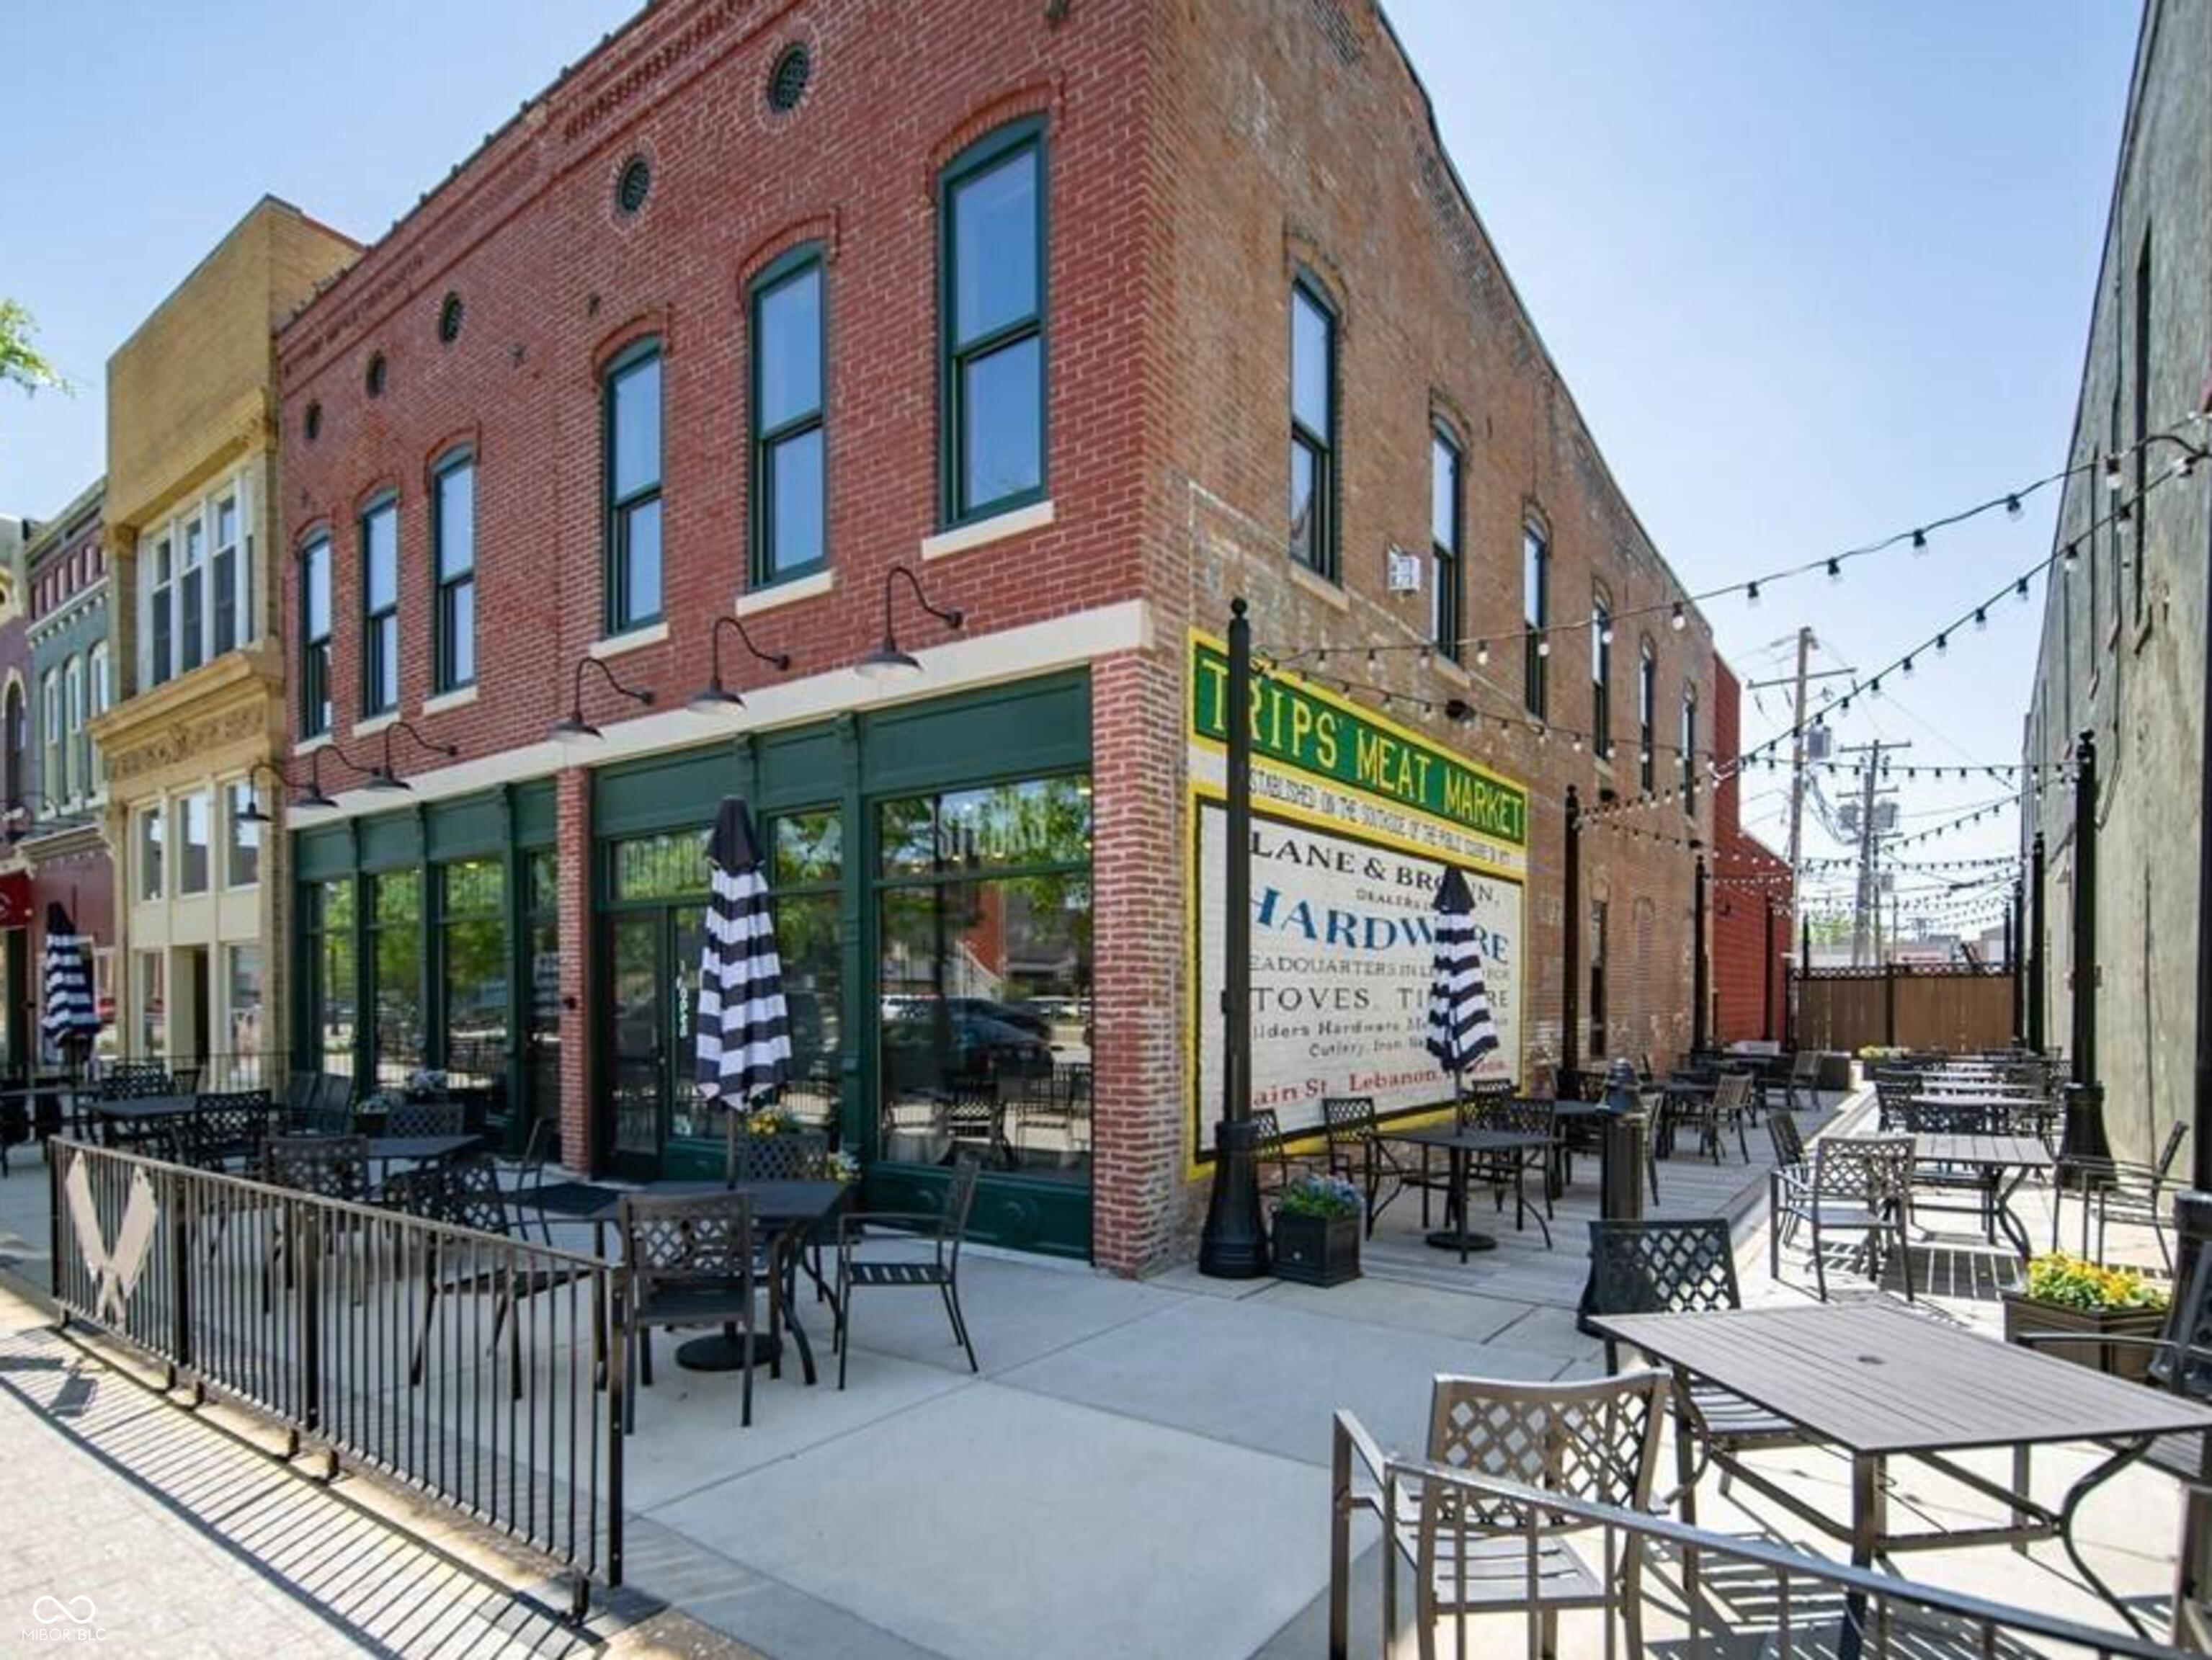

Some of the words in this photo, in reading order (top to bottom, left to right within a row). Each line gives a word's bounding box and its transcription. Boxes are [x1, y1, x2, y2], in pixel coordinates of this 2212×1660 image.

[1357, 728, 1430, 803] MEAT
[1444, 766, 1522, 839] MARKET
[1250, 831, 1355, 873] LANE
[1363, 857, 1386, 881] &
[1250, 887, 1508, 965] HARDWRE
[1250, 955, 1396, 975] EADQUARTERS
[1250, 987, 1370, 1012] TOVES
[1253, 1083, 1298, 1107] ain
